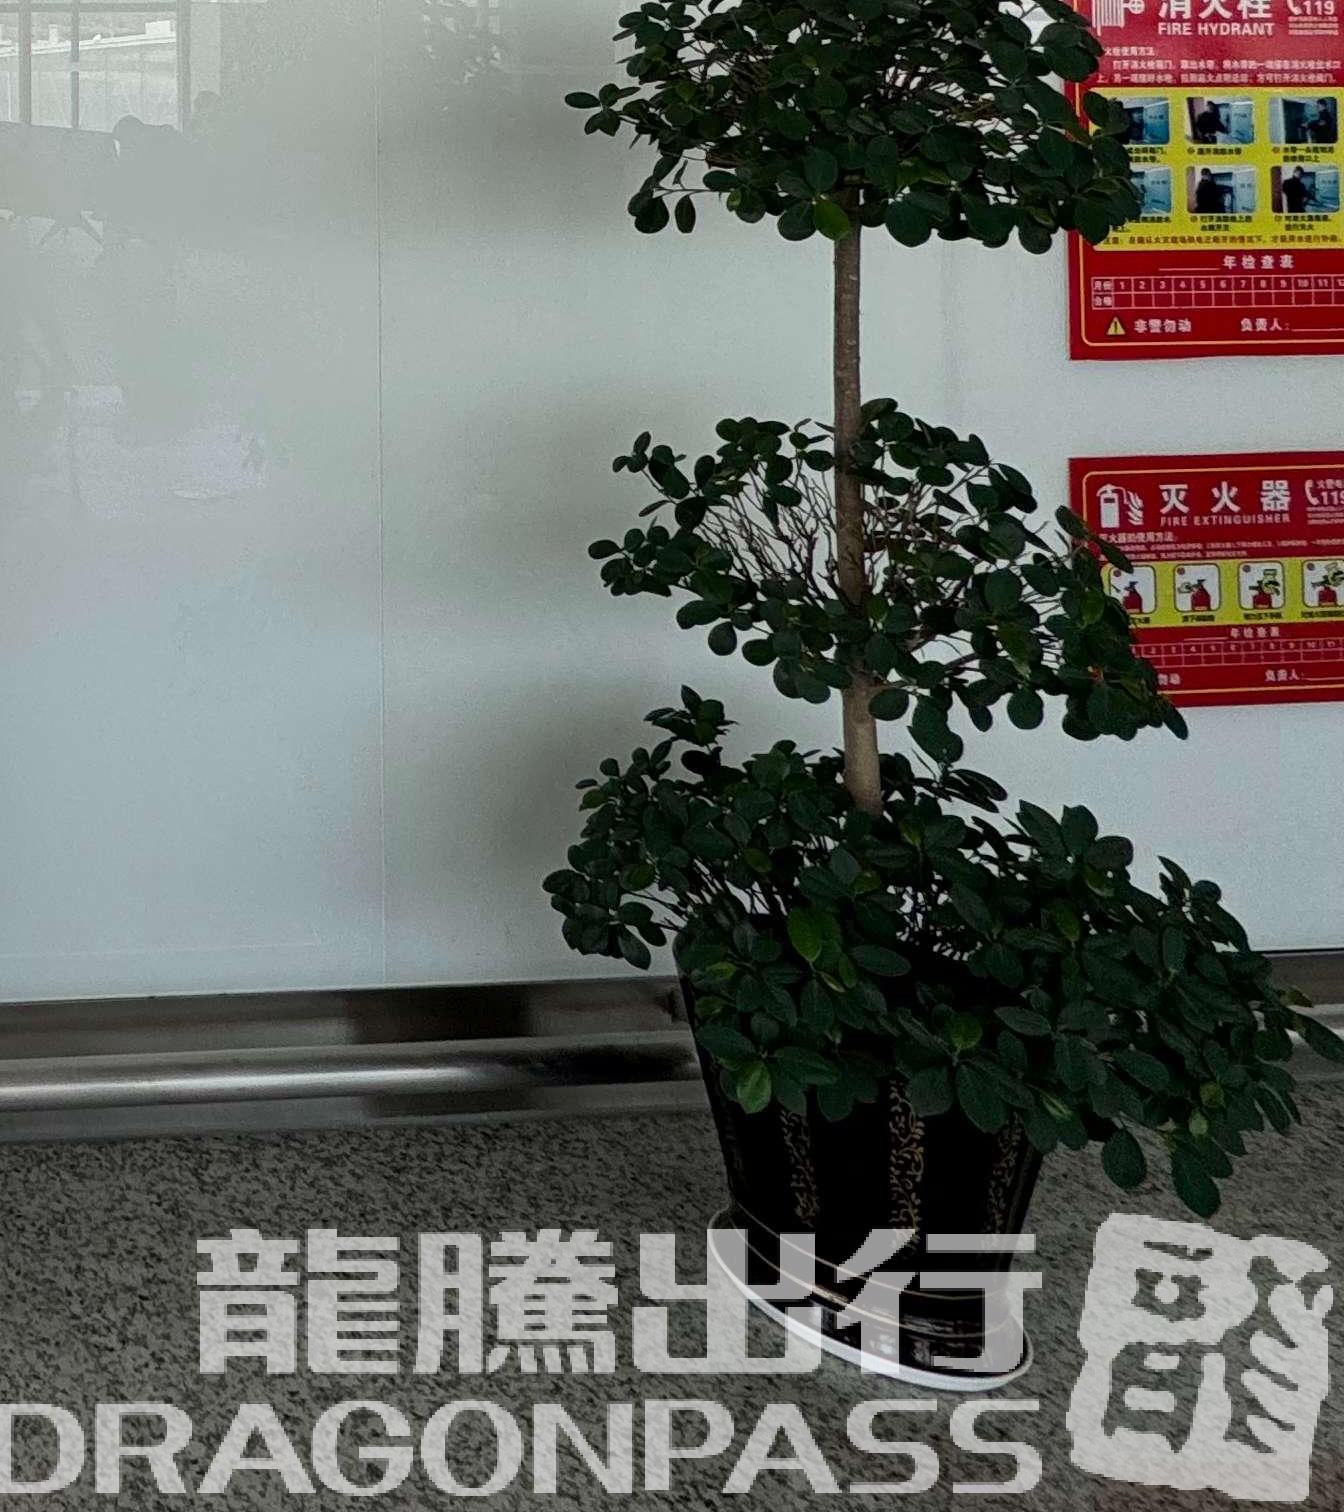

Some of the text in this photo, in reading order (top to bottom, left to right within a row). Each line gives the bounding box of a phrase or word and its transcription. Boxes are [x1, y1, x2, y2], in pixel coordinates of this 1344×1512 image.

[1302, 0, 1335, 16] 119
[1157, 22, 1193, 36] FIRE
[1197, 21, 1275, 36] HYDRANT
[1158, 479, 1292, 514] 灭火器
[1160, 512, 1291, 527] FIRE EXTINGUISHER
